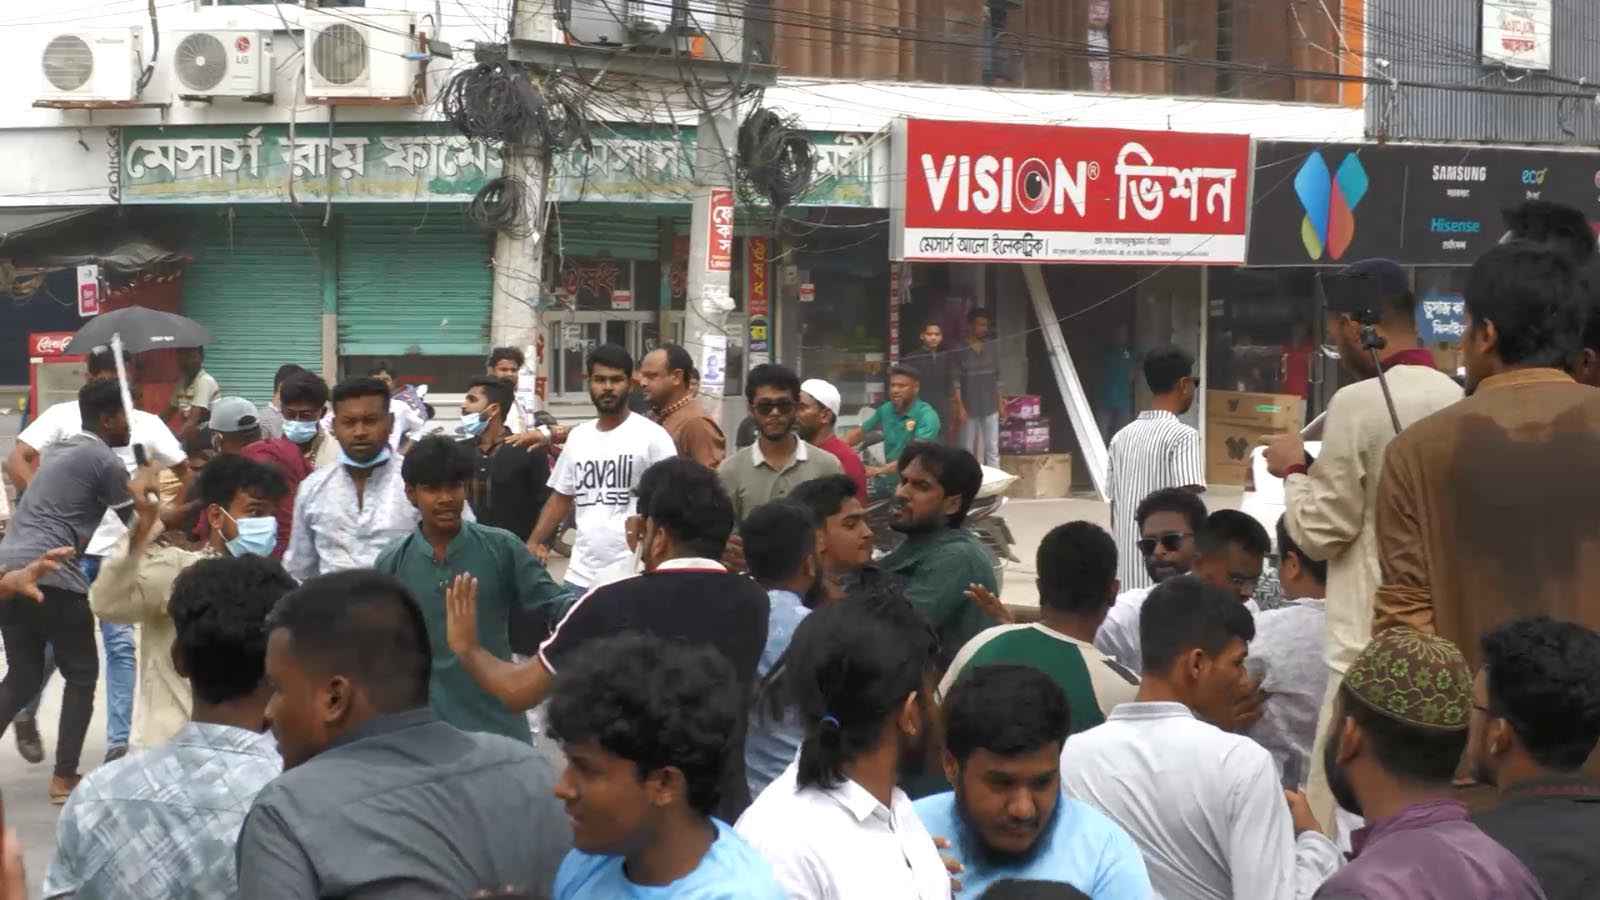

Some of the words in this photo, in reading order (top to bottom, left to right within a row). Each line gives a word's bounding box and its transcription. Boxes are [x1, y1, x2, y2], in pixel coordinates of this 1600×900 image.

[126, 126, 263, 179] মেসার্স
[1114, 141, 1237, 223] ভিশন
[1432, 165, 1487, 182] SAMSUNG
[1431, 218, 1480, 232] Hisense
[919, 233, 954, 253] মেসার্স
[957, 236, 989, 254] আলো
[575, 454, 633, 491] cavalli
